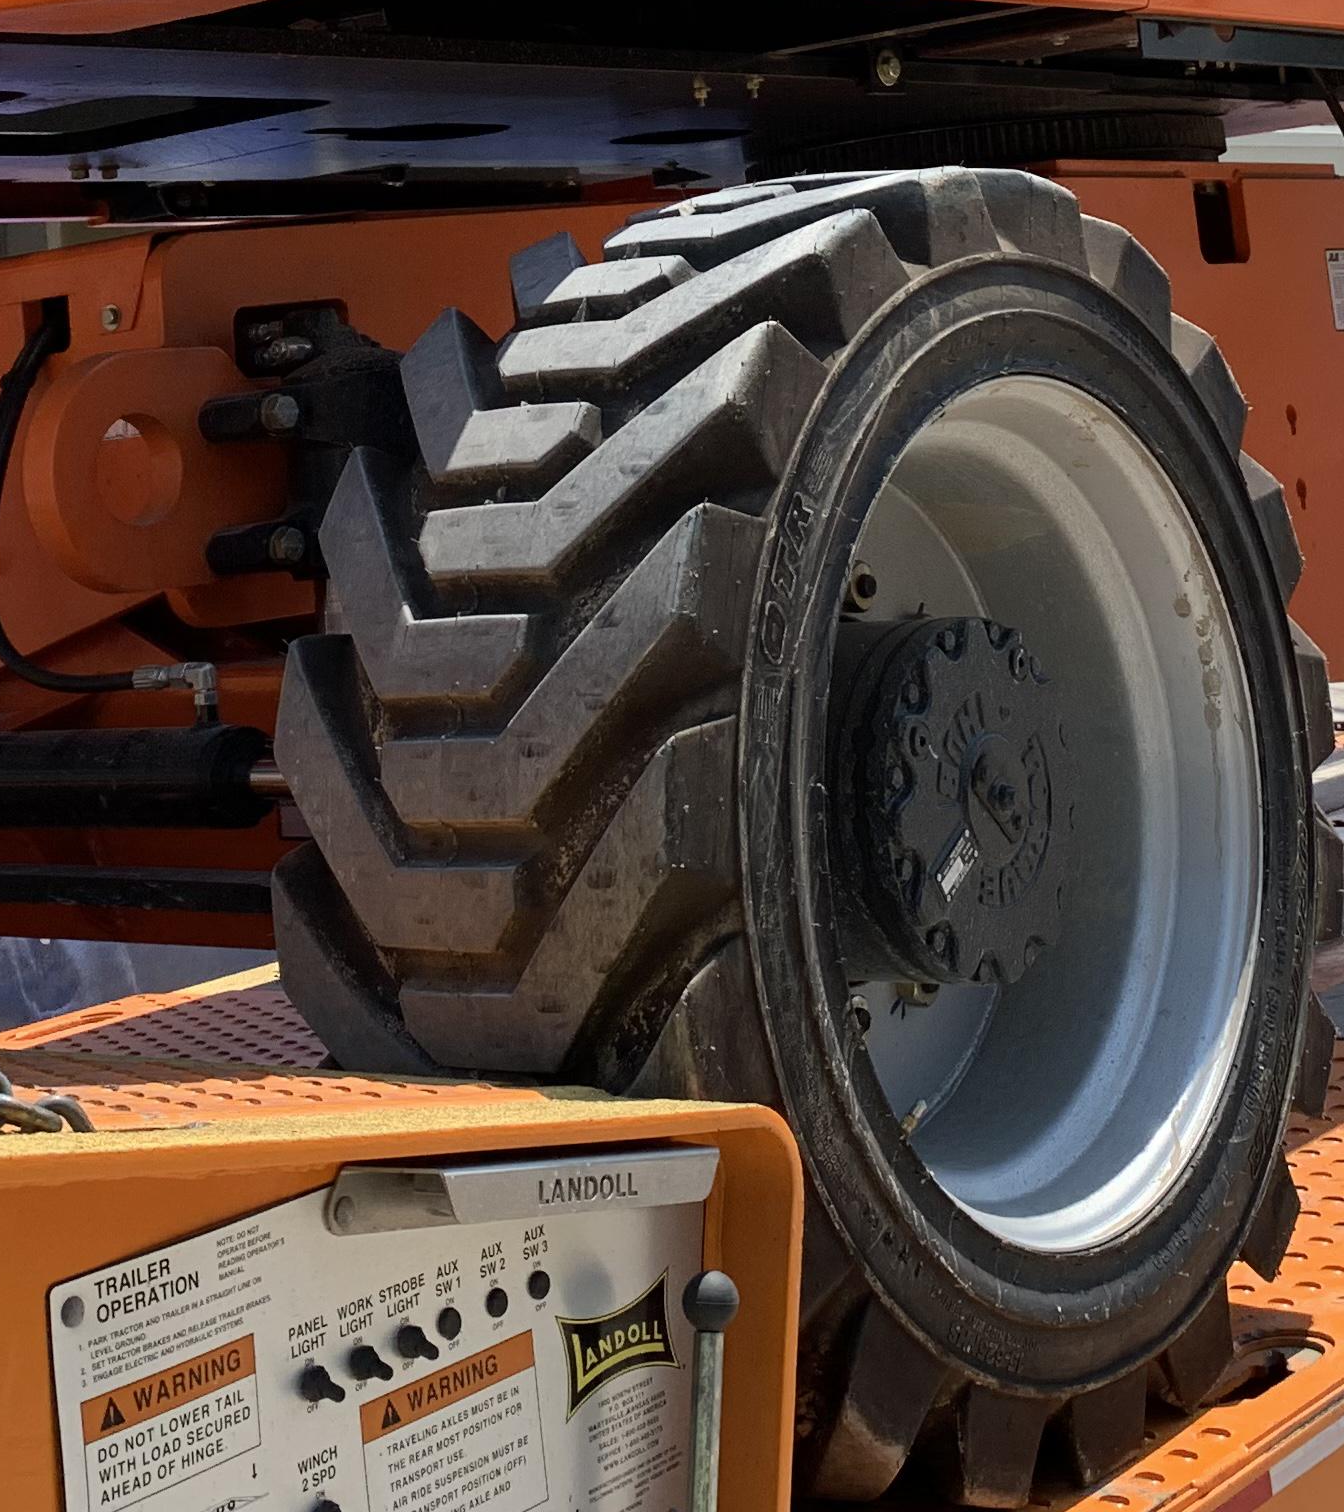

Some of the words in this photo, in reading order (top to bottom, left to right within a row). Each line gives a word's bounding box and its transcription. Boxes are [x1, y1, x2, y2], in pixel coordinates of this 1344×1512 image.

[537, 1172, 639, 1205] LANDOLL
[217, 1242, 246, 1259] OPERATE
[247, 1231, 271, 1248] BEFORE
[523, 1224, 546, 1244] AUX
[218, 1253, 246, 1270] READING
[481, 1241, 503, 1262] AUX
[522, 1243, 542, 1261] SW
[542, 1239, 549, 1254] 3
[94, 1258, 171, 1299] TRAILER
[218, 1265, 245, 1281] MANUAL
[436, 1259, 459, 1280] AUX
[479, 1261, 499, 1279] SW
[499, 1257, 507, 1272] 2
[96, 1271, 200, 1324] OPERATION
[379, 1272, 426, 1304] STROBE
[435, 1279, 455, 1297] SW
[456, 1276, 462, 1290] 1
[87, 1334, 108, 1349] PARK
[110, 1321, 144, 1341] TRACTOR
[146, 1315, 161, 1329] AND
[162, 1304, 190, 1322] TRAILER
[206, 1284, 237, 1306] STRAIGHT
[237, 1279, 251, 1294] LINE
[336, 1294, 374, 1321] WORK
[386, 1292, 421, 1319] LIGHT
[91, 1359, 105, 1373] SET
[107, 1348, 141, 1368] TRACTOR
[142, 1335, 171, 1355] BRAKES
[172, 1328, 187, 1343] AND
[188, 1317, 217, 1338] RELEASE
[217, 1305, 245, 1325] TRAILER
[288, 1314, 328, 1342] PANEL
[339, 1312, 374, 1338] LIGHT
[90, 1344, 113, 1360] LEVEL
[92, 1365, 123, 1384] ENGAGE
[124, 1350, 159, 1372] ELECTRIC
[160, 1345, 175, 1360] AND
[175, 1328, 213, 1352] HYDRAULIC
[290, 1332, 326, 1360] LIGHT
[571, 1320, 665, 1393] LANDOLL
[132, 1348, 242, 1413] WARNING
[407, 1353, 499, 1412] WARNING
[97, 1443, 119, 1464] DO
[125, 1428, 155, 1453] NOT
[160, 1401, 210, 1437] LOWER
[214, 1389, 245, 1413] TAIL
[387, 1424, 438, 1457] TRAVELING
[440, 1410, 469, 1433] AXLES
[471, 1399, 495, 1417] MUST
[497, 1390, 508, 1404] BE
[510, 1385, 520, 1398] IN
[98, 1457, 136, 1485] WITH
[142, 1438, 181, 1465] LOAD
[186, 1405, 251, 1446] SECURED
[388, 1458, 406, 1475] THE
[409, 1446, 434, 1465] REAR
[436, 1432, 461, 1452] MOST
[463, 1411, 503, 1440] POSITION
[505, 1401, 523, 1418] FOR
[100, 1472, 152, 1505] AHEAD
[157, 1460, 176, 1480] OF
[181, 1438, 229, 1470] HINGE.
[297, 1445, 339, 1475] WINCH
[390, 1458, 444, 1493] TRANSPORT
[392, 1494, 409, 1512] AIR
[410, 1484, 432, 1502] RIDE
[434, 1454, 491, 1490] SUSPENSION
[492, 1441, 514, 1462] MUST
[517, 1434, 529, 1448] BE
[301, 1478, 310, 1493] 2
[311, 1464, 337, 1489] SPD
[461, 1466, 502, 1498] POSITION
[504, 1454, 528, 1476] (OFF)
[467, 1489, 491, 1510] AXLE
[492, 1479, 511, 1497] AND
